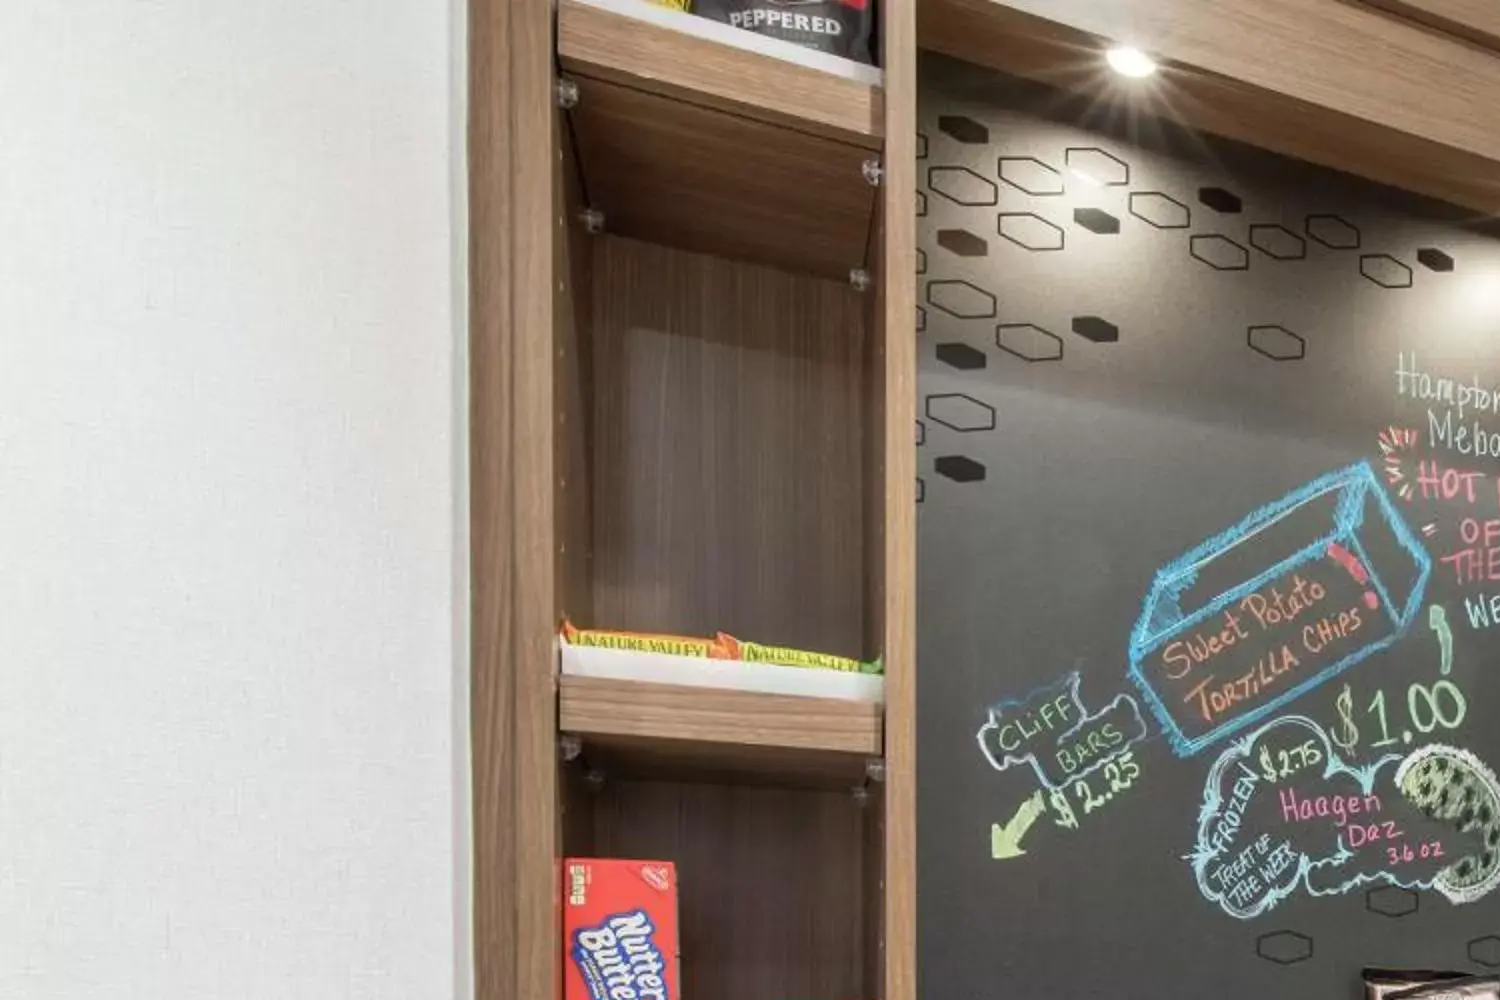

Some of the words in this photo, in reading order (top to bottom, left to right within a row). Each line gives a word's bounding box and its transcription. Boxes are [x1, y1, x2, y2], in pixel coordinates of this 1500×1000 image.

[729, 8, 842, 36] PEPPERED
[1417, 460, 1486, 503] HOT
[1162, 610, 1249, 680] Sweet
[1240, 573, 1327, 631] Potato
[1330, 680, 1467, 756] $1.00
[1055, 723, 1123, 773] BARS
[1259, 739, 1323, 784] $2.75
[1212, 761, 1261, 853] FROZEN
[1278, 787, 1382, 827] Haagen
[1348, 820, 1405, 848] Daz
[1210, 845, 1257, 890] TREAT
[1227, 875, 1263, 907] THE
